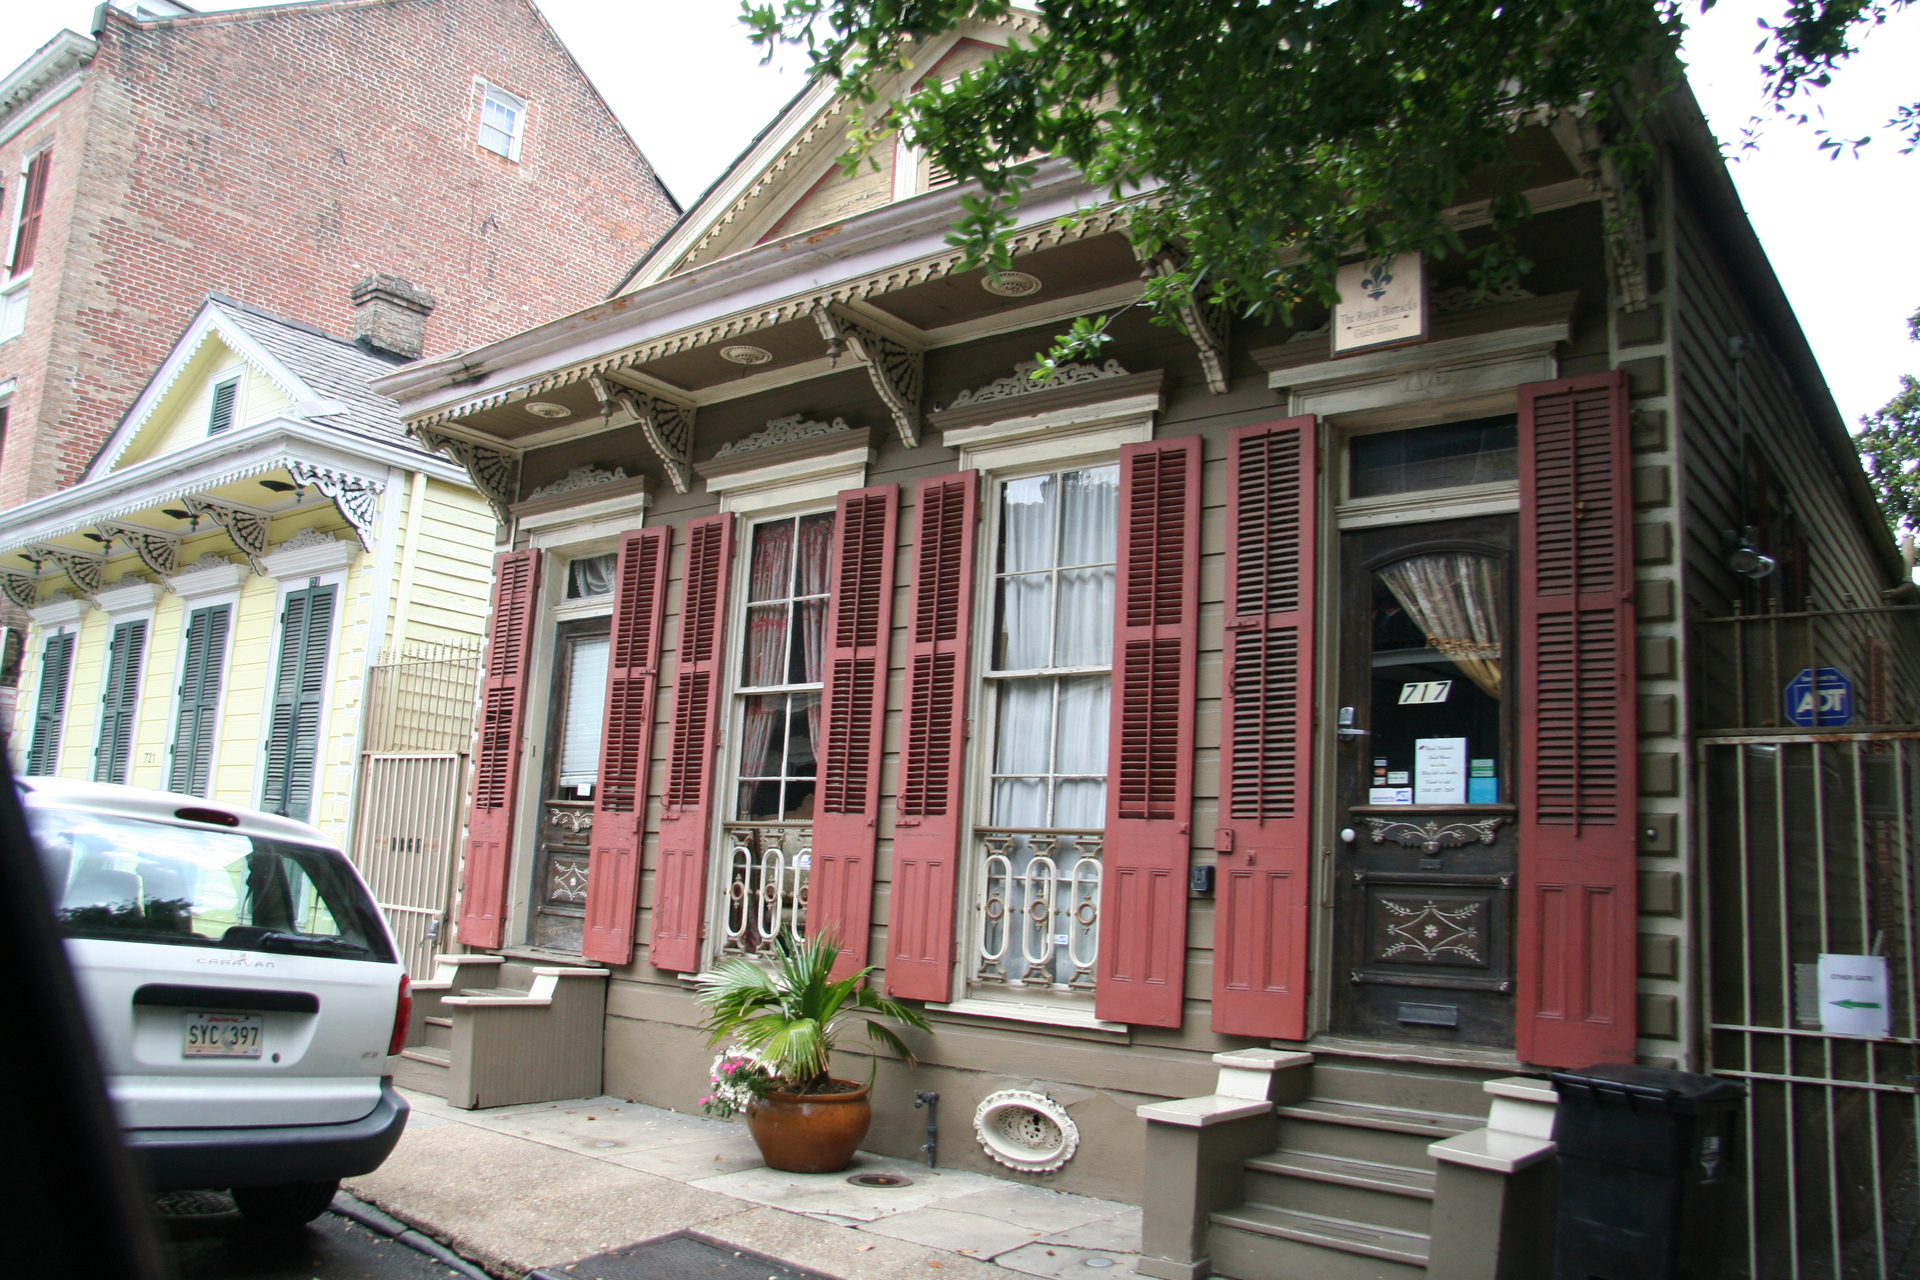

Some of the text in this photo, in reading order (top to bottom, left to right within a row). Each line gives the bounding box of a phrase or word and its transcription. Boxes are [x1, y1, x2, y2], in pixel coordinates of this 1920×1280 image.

[1340, 313, 1355, 325] The
[1357, 307, 1380, 322] Royal
[1354, 326, 1375, 338] Guest
[1403, 681, 1449, 703] 717
[1796, 688, 1847, 713] ADT
[143, 752, 156, 764] 721
[195, 956, 276, 968] CARAVAN
[189, 1024, 260, 1046] SYC 397
